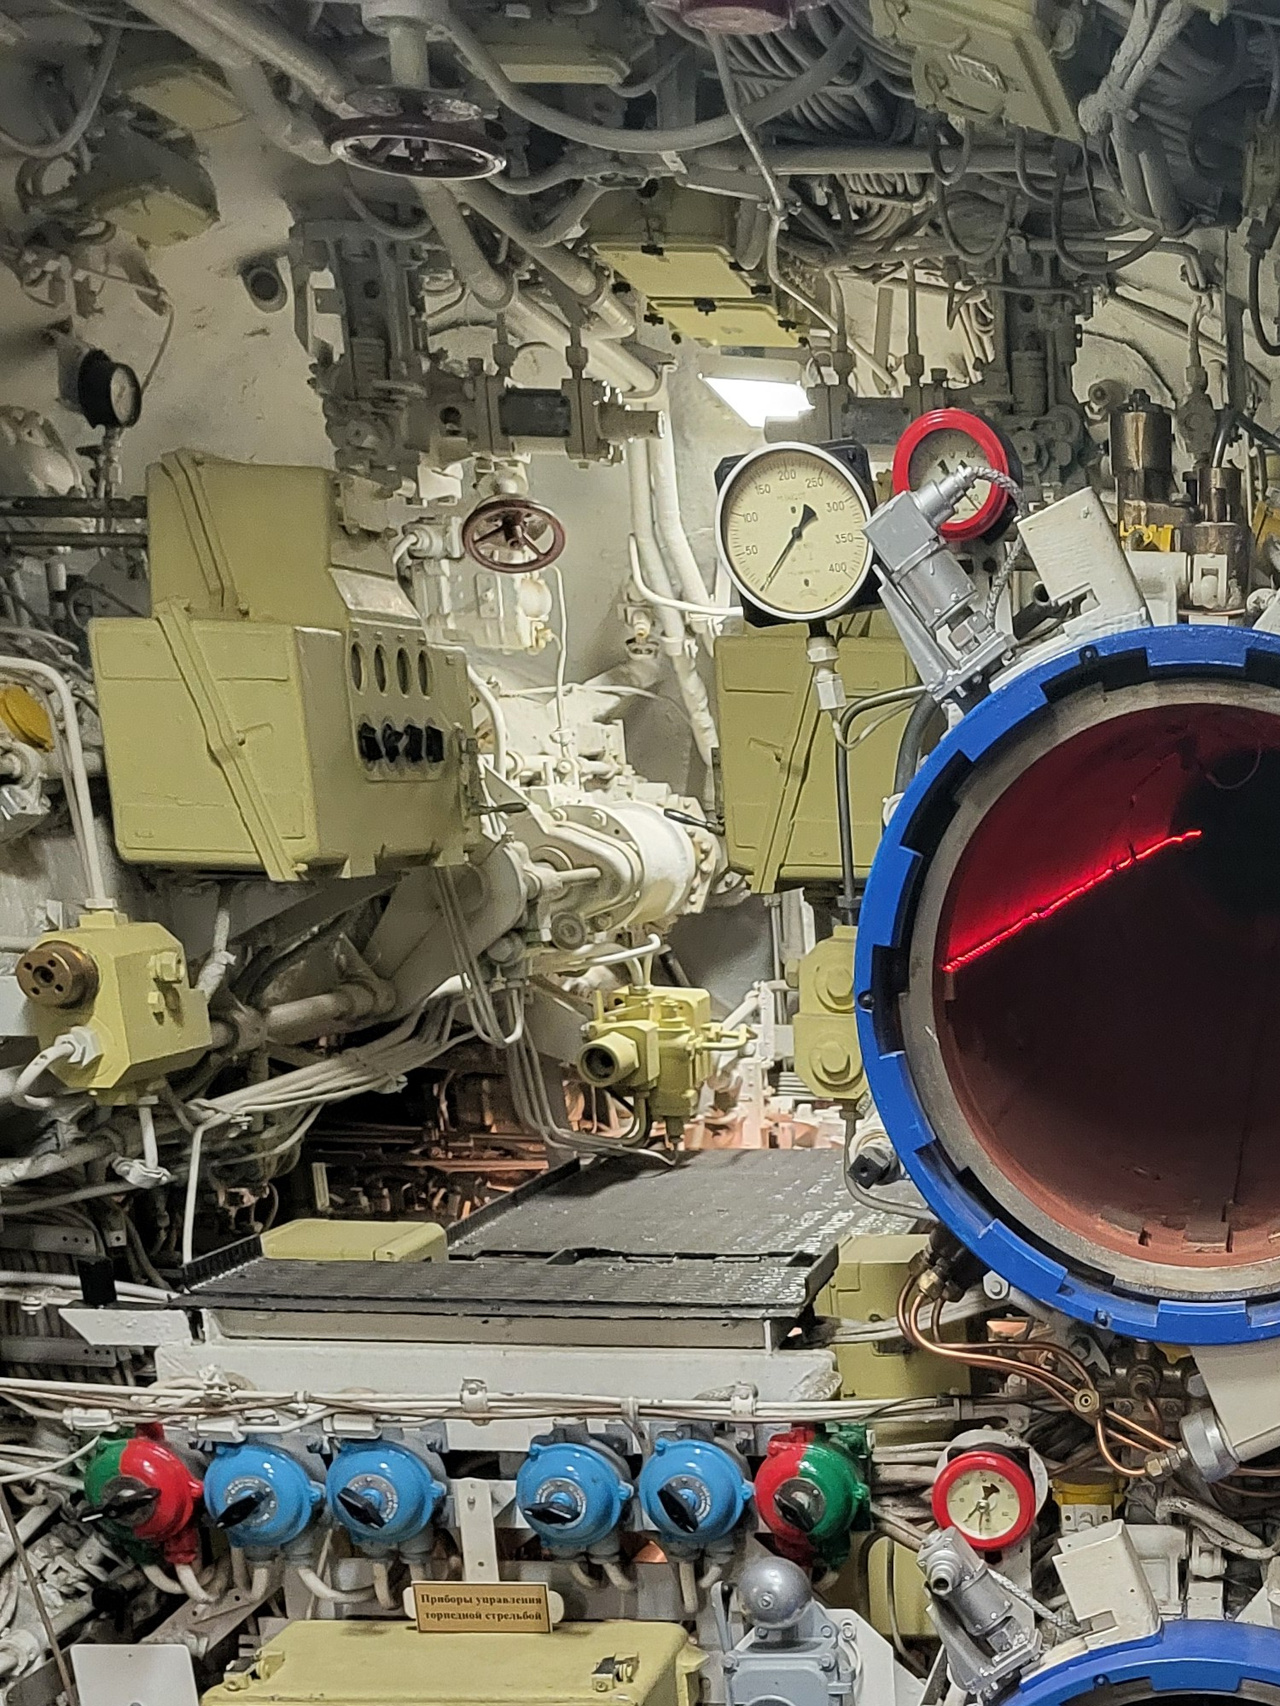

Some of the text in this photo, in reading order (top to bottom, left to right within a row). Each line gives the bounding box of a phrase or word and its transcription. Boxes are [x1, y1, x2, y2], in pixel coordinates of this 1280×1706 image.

[779, 470, 796, 481] 200
[805, 478, 823, 488] 250
[755, 484, 771, 495] 150
[826, 502, 844, 513] 300
[744, 512, 758, 523] 100
[835, 533, 853, 544] 350
[746, 546, 758, 555] 50
[829, 562, 847, 573] 400
[421, 1594, 542, 1605] Приборы управления
[425, 1611, 542, 1621] торпедной стрельбой
